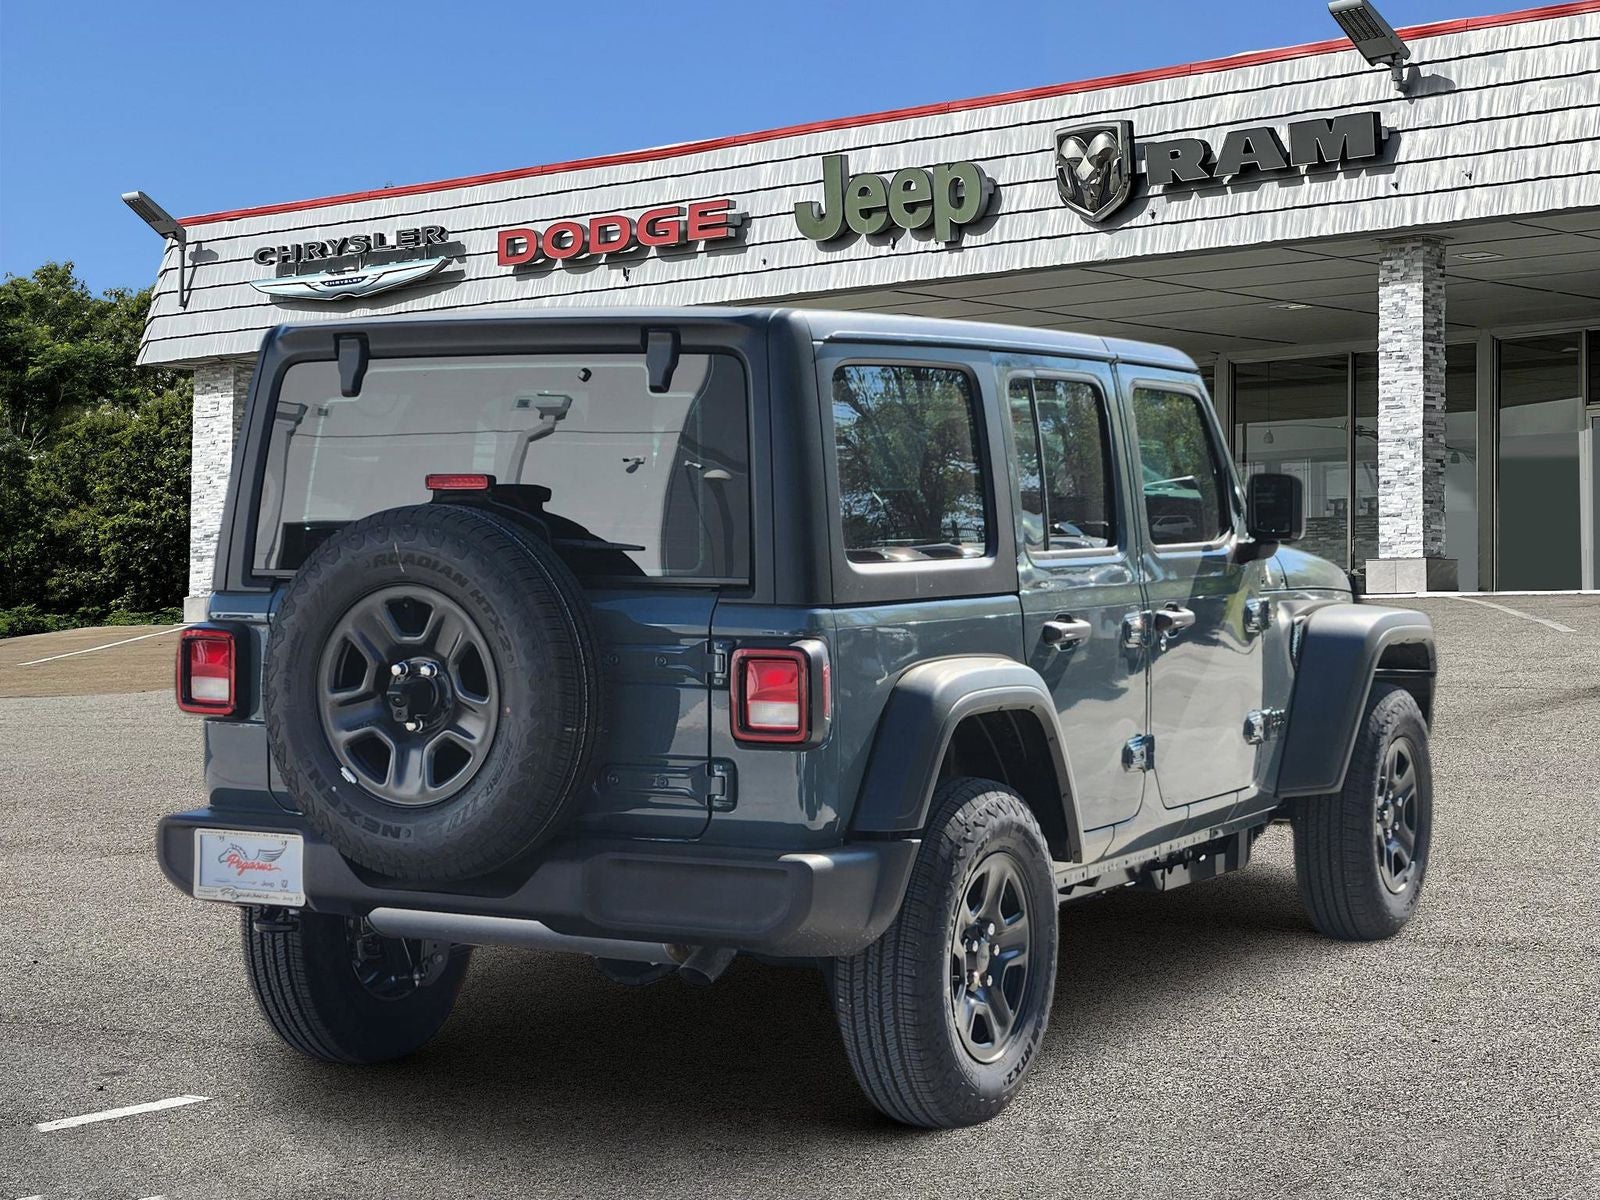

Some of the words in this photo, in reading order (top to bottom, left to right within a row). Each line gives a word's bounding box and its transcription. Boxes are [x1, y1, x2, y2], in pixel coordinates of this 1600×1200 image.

[1145, 111, 1381, 186] RAM
[794, 154, 990, 242] Jeep
[253, 225, 448, 266] CHRYSLER
[497, 199, 736, 267] DODGE
[324, 277, 363, 286] CHRYSLER
[371, 552, 470, 588] ROADIAN
[306, 767, 401, 840] NEXEN
